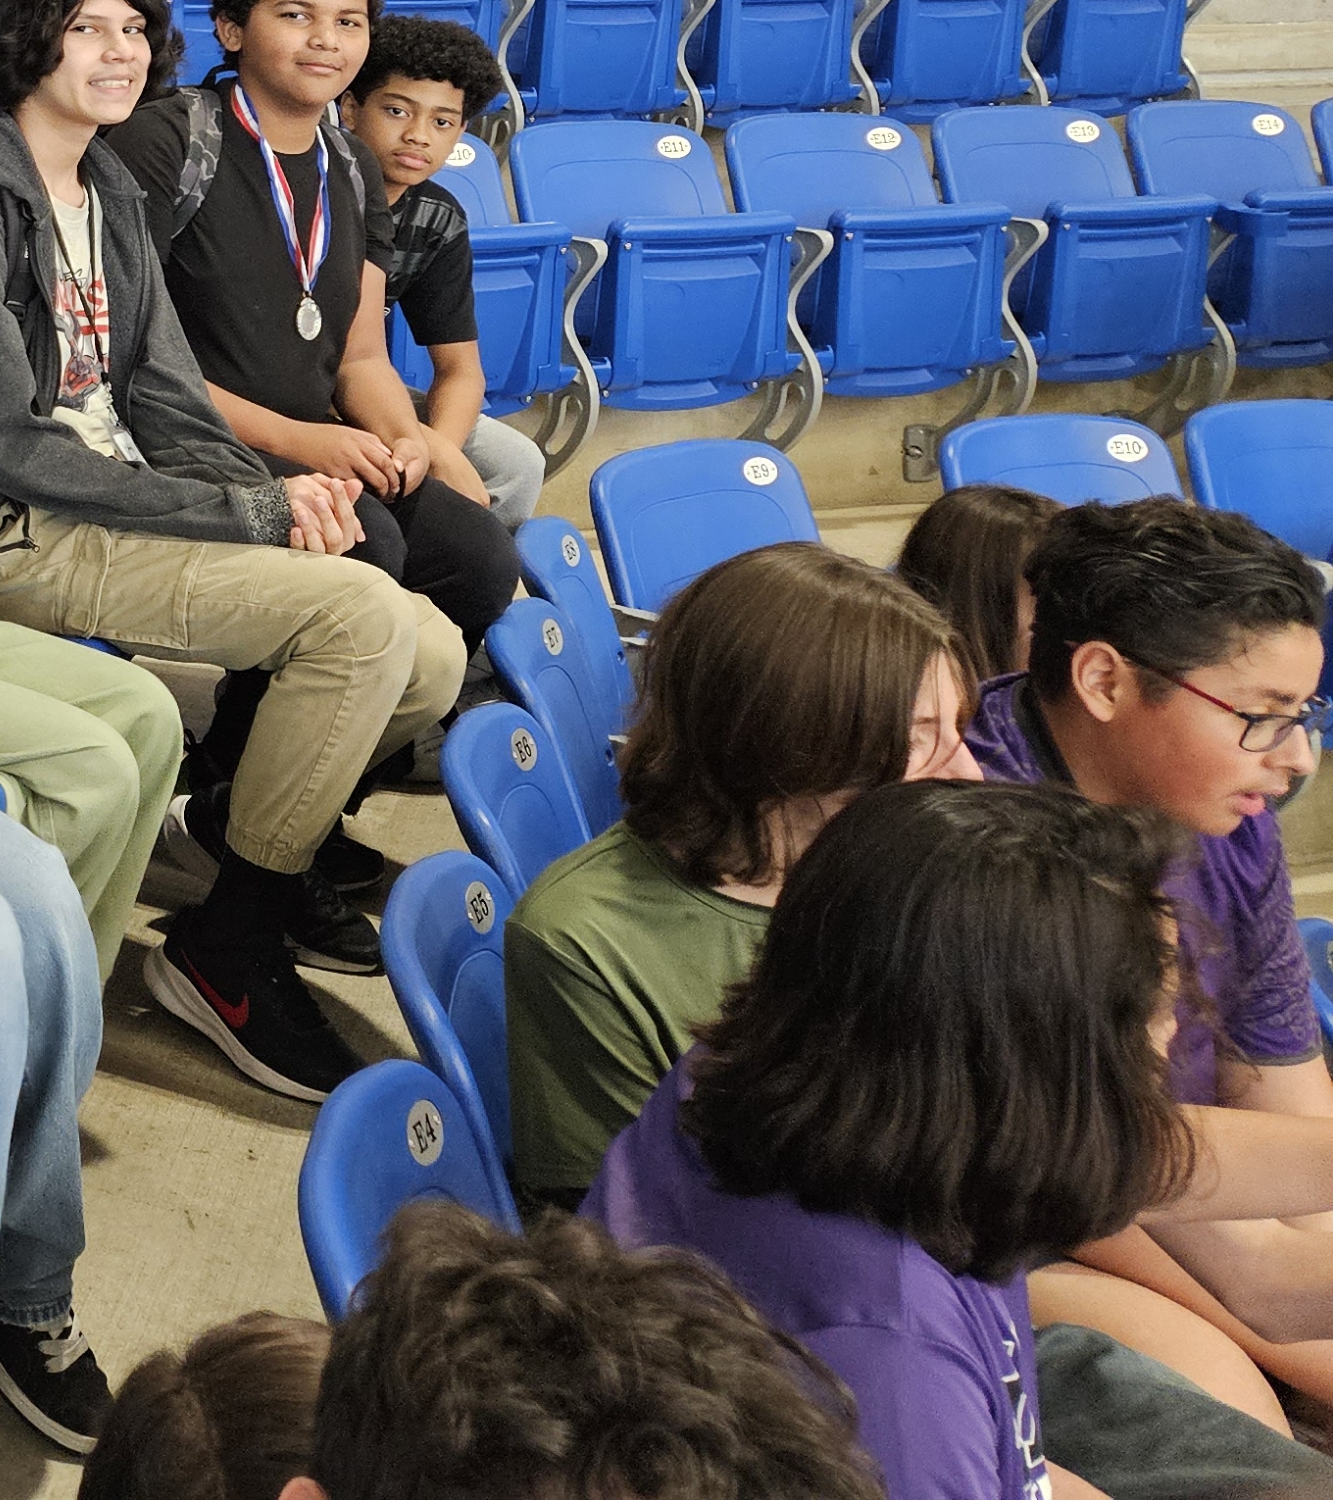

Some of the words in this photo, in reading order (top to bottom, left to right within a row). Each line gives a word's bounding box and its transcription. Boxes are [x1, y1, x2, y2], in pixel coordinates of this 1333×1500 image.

[1258, 119, 1279, 130] E14
[1072, 126, 1095, 137] E13
[873, 132, 896, 144] E12
[664, 141, 685, 153] E11
[449, 148, 471, 160] 10
[1113, 442, 1141, 454] E10
[750, 464, 769, 479] E9
[546, 627, 559, 648] E7
[515, 736, 532, 763] E6
[469, 891, 489, 924] E5
[412, 1113, 437, 1154] E4
